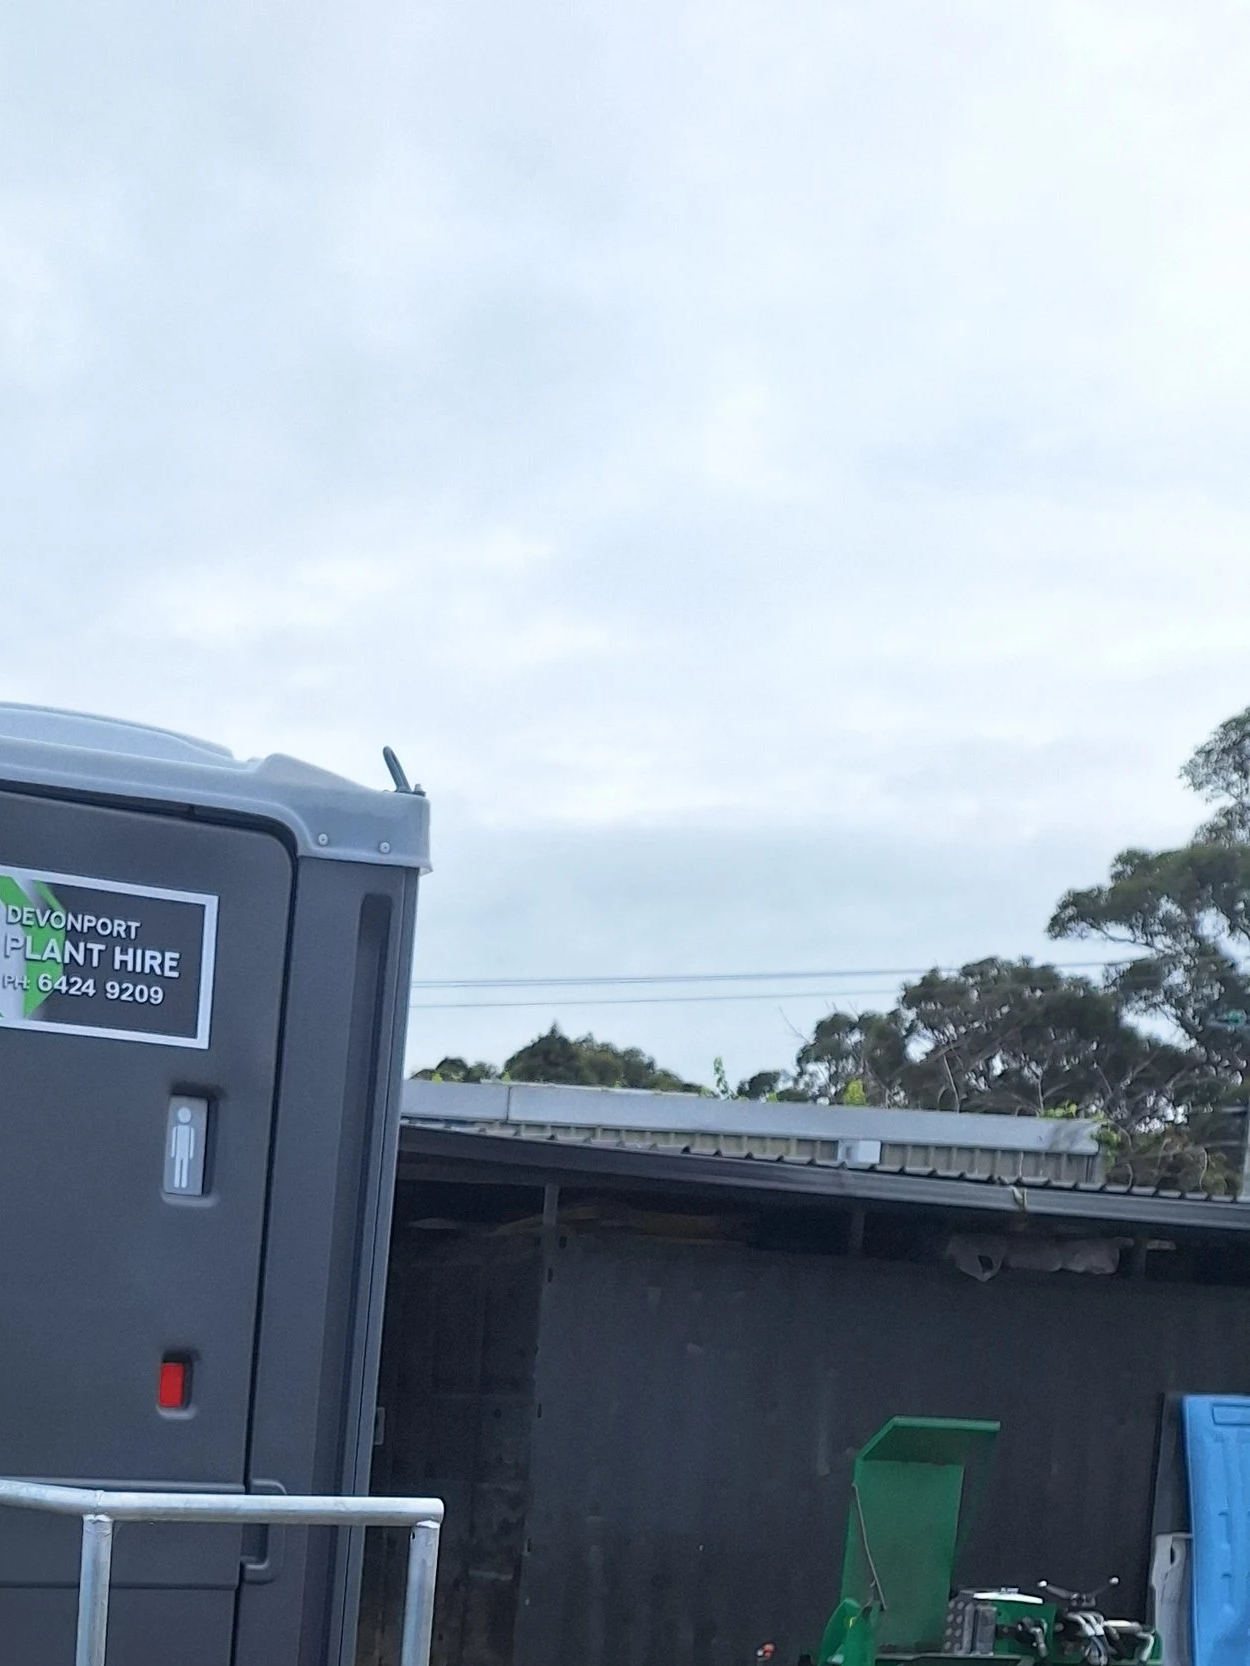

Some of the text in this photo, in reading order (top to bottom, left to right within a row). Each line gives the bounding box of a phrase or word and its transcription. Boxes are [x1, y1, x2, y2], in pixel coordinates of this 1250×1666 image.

[6, 904, 142, 941] DEVONPORT
[4, 933, 181, 979] PLANT HIRE
[37, 972, 97, 998] 6424
[105, 980, 165, 1006] 9209
